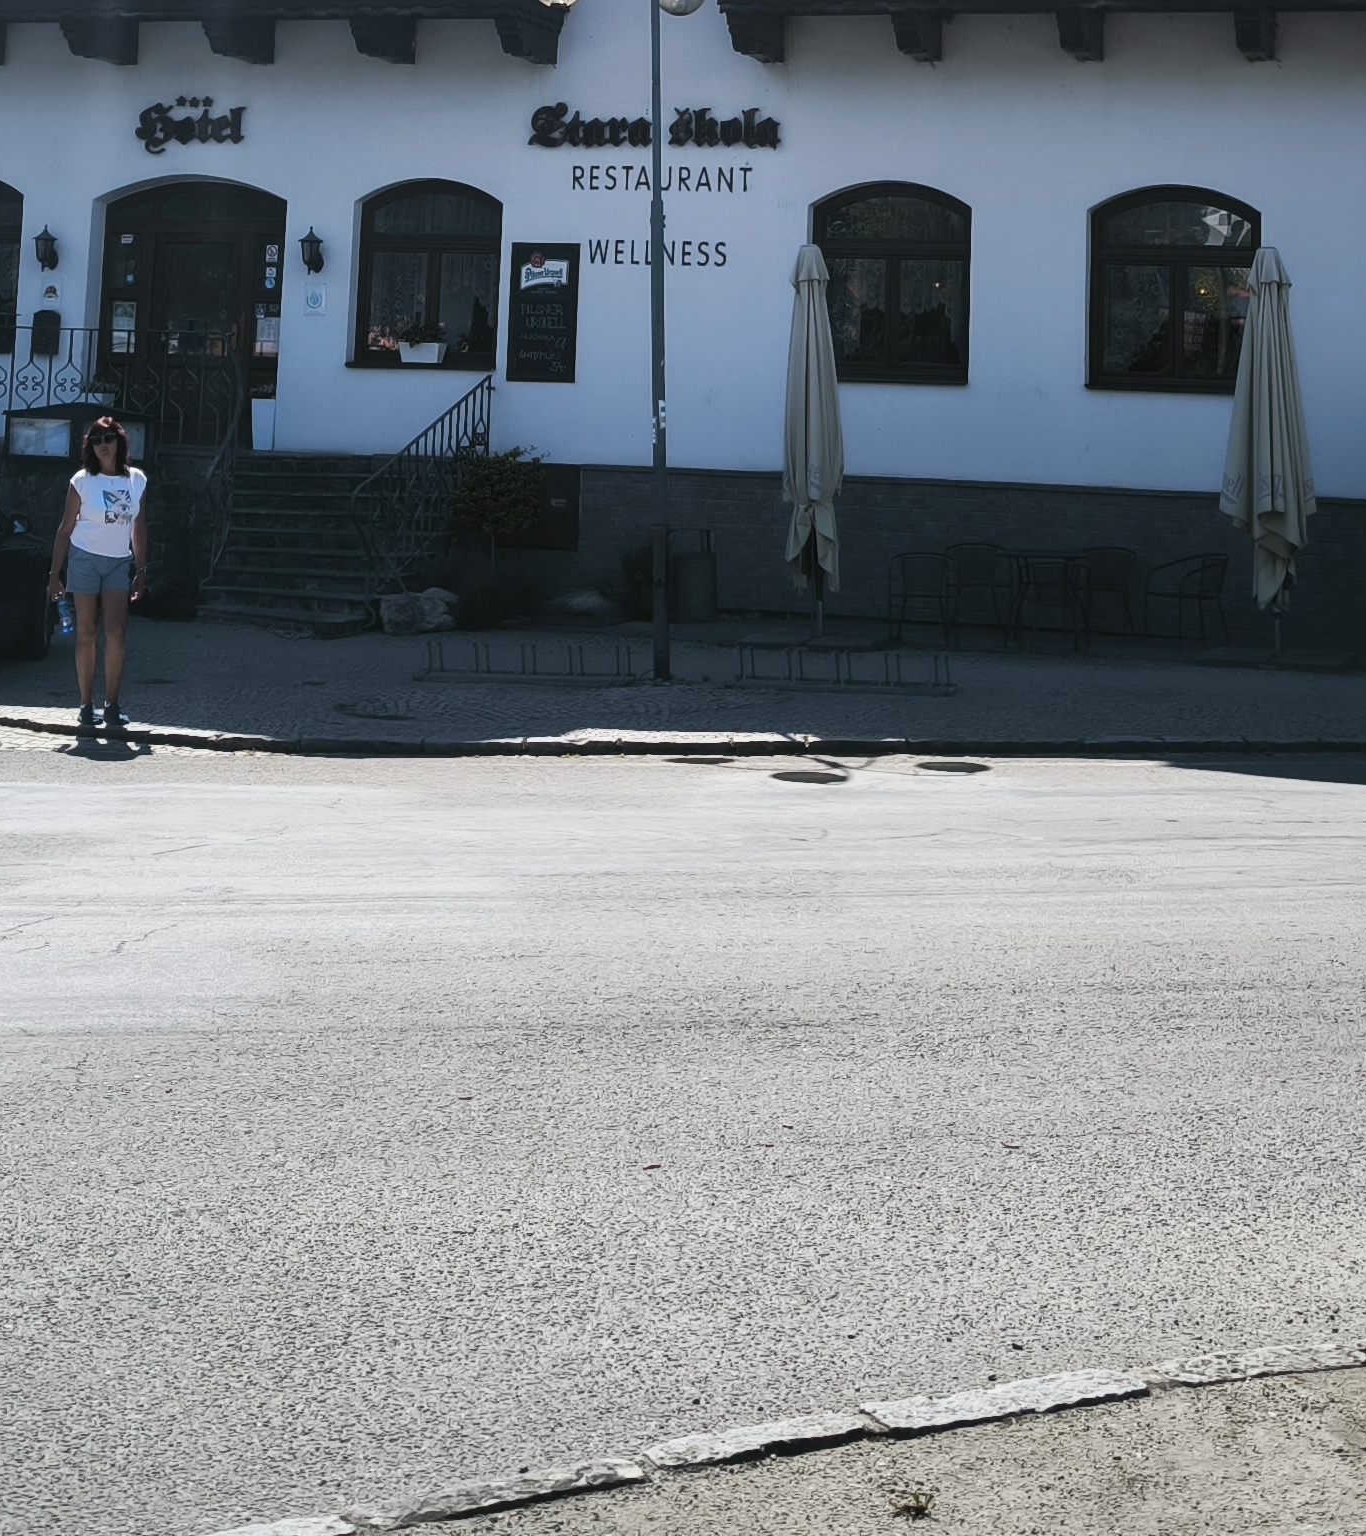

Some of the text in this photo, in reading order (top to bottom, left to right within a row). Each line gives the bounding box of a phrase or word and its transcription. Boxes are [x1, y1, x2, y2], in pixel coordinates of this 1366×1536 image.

[134, 102, 248, 155] Hotel
[572, 165, 753, 194] RESTAURANT
[588, 239, 728, 268] WELLNESS
[521, 303, 564, 315] PILSNER
[526, 317, 566, 329] URQUELL
